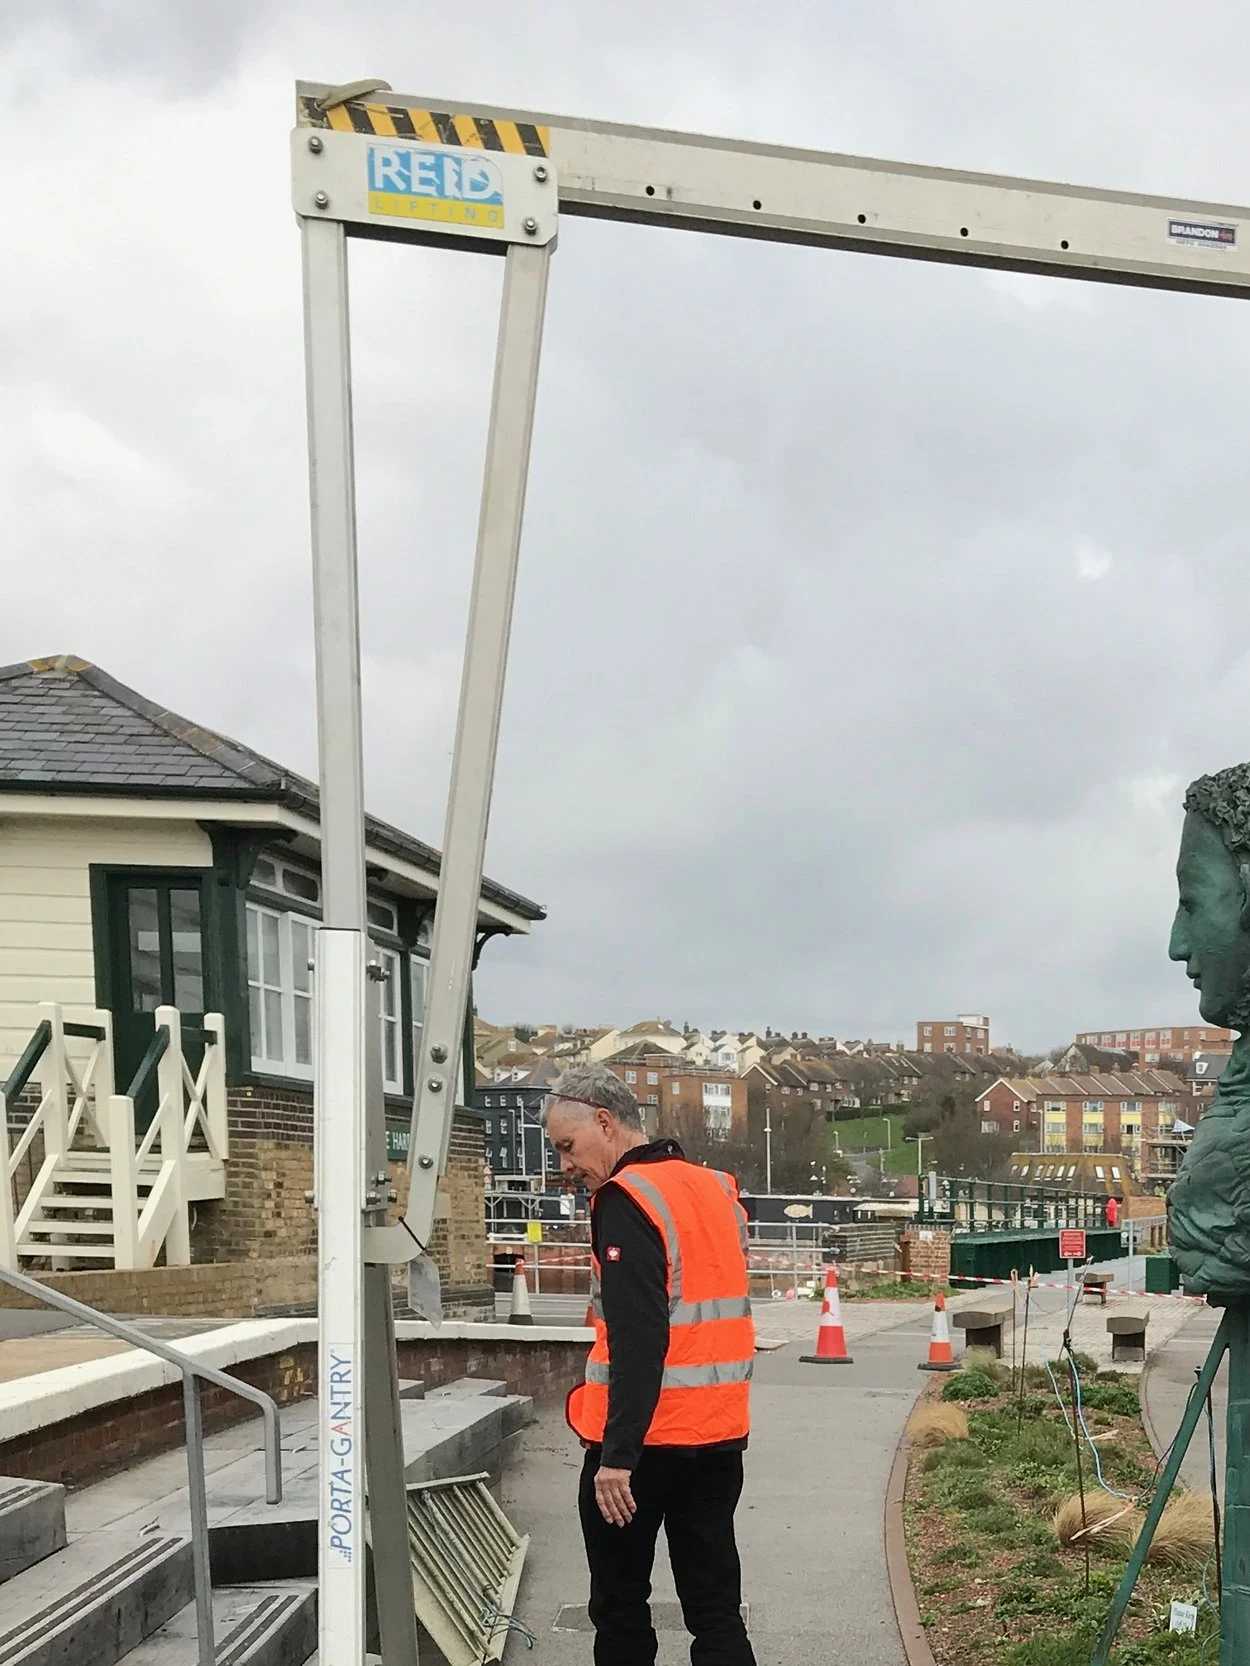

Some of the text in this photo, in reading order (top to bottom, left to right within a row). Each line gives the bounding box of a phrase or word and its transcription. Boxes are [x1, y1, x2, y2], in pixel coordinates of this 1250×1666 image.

[373, 149, 500, 200] REID
[374, 196, 499, 223] LIFTING
[1170, 223, 1220, 239] BRANDON
[329, 1353, 353, 1549] PORTA-GANTRY
